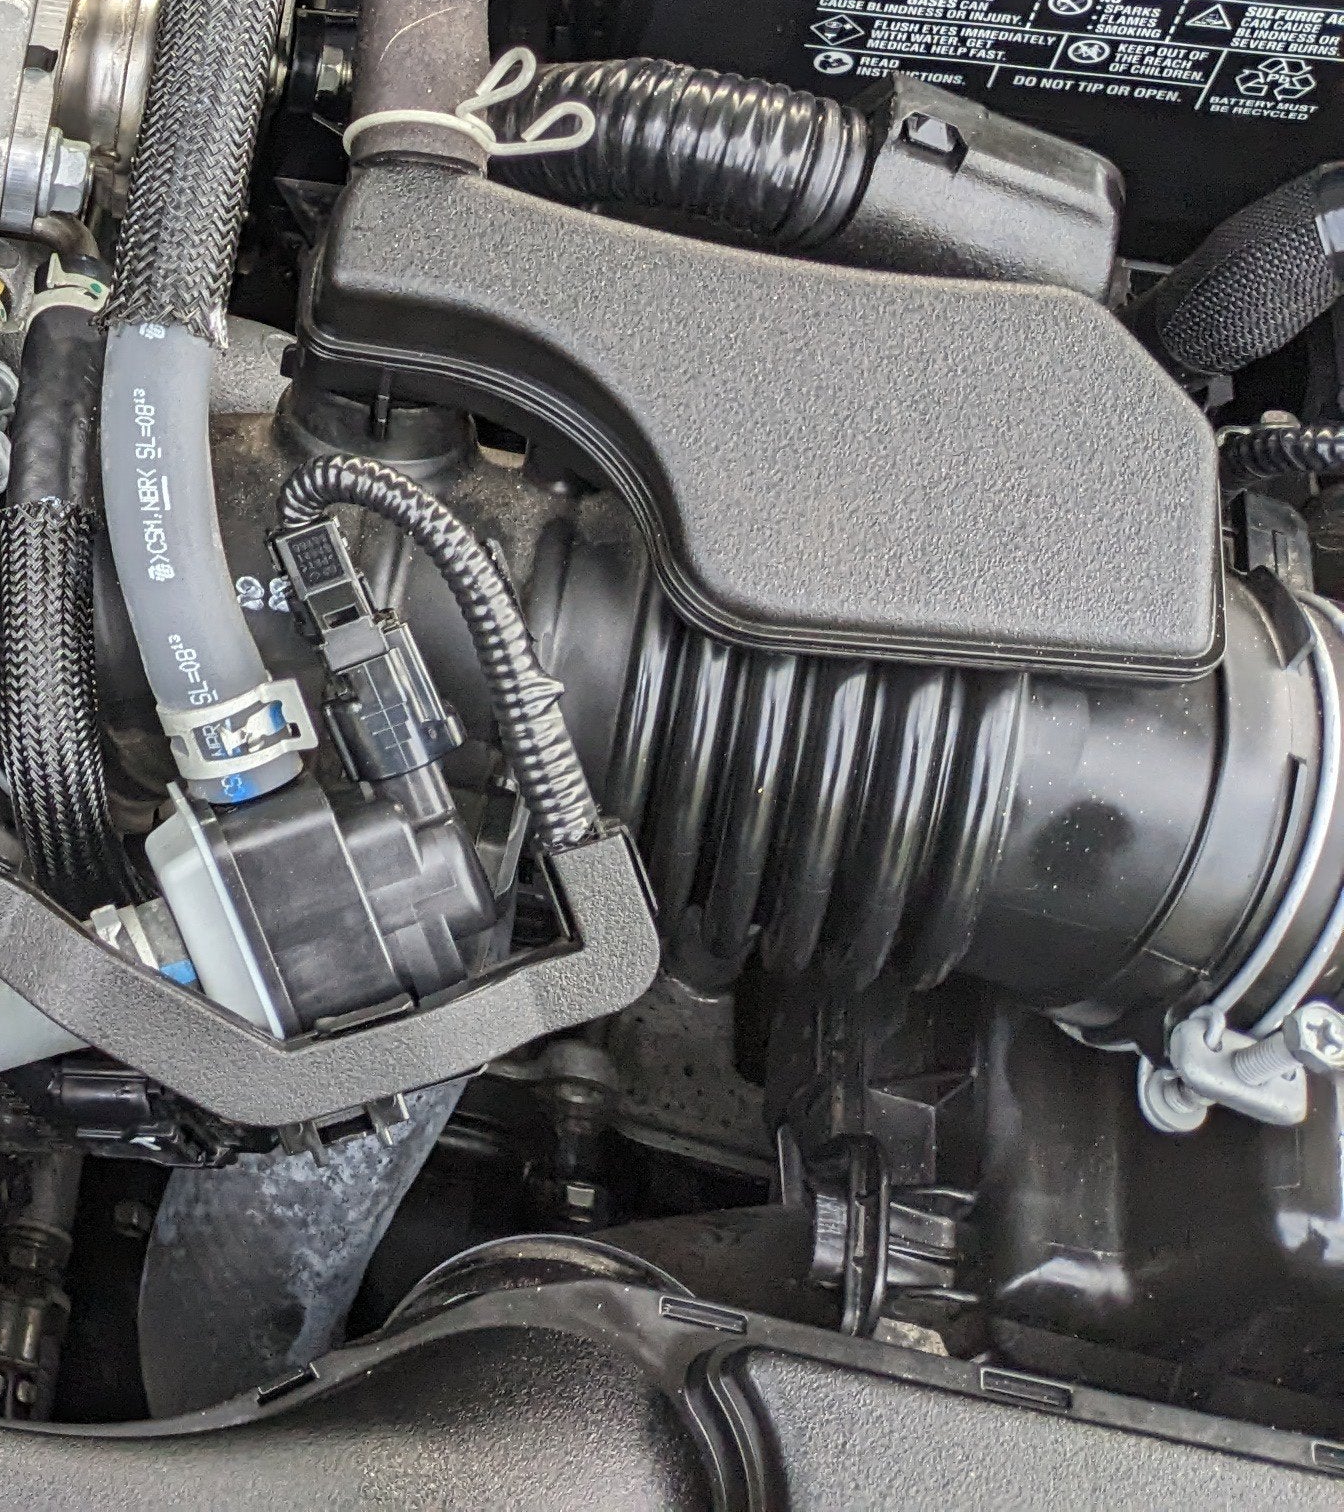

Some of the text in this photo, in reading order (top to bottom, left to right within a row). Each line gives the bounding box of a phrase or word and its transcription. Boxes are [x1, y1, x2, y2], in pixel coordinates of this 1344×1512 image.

[866, 2, 943, 18] BLINDNESS
[946, 10, 967, 19] OR
[970, 12, 1023, 25] INJURY.
[959, 0, 989, 11] CAN
[1103, 4, 1162, 18] SPARKS
[1099, 13, 1158, 28] FLAMES
[1244, 7, 1323, 23] SULFURIC
[873, 19, 1056, 46] FLUSH EYES IMMEDIATELY
[1094, 24, 1162, 39] SMOKING
[1240, 17, 1322, 34] CAN CAUSE
[871, 30, 993, 49] WITH WATER. GET
[1235, 27, 1340, 46] BLINDNESS OR
[866, 39, 1007, 61] MEDICAL HELP FAST.
[1117, 42, 1210, 61] KEEP OUT OF
[1230, 37, 1341, 57] SEVERE BURNS.
[859, 56, 900, 68] READ
[1114, 53, 1193, 69] THE REACH
[1109, 63, 1205, 83] OF CHILDREN.
[1013, 75, 1182, 103] DO NOT TIP OR OPEN.
[1209, 96, 1319, 113] BATTERY MUST
[1231, 107, 1309, 121] RECYCLED
